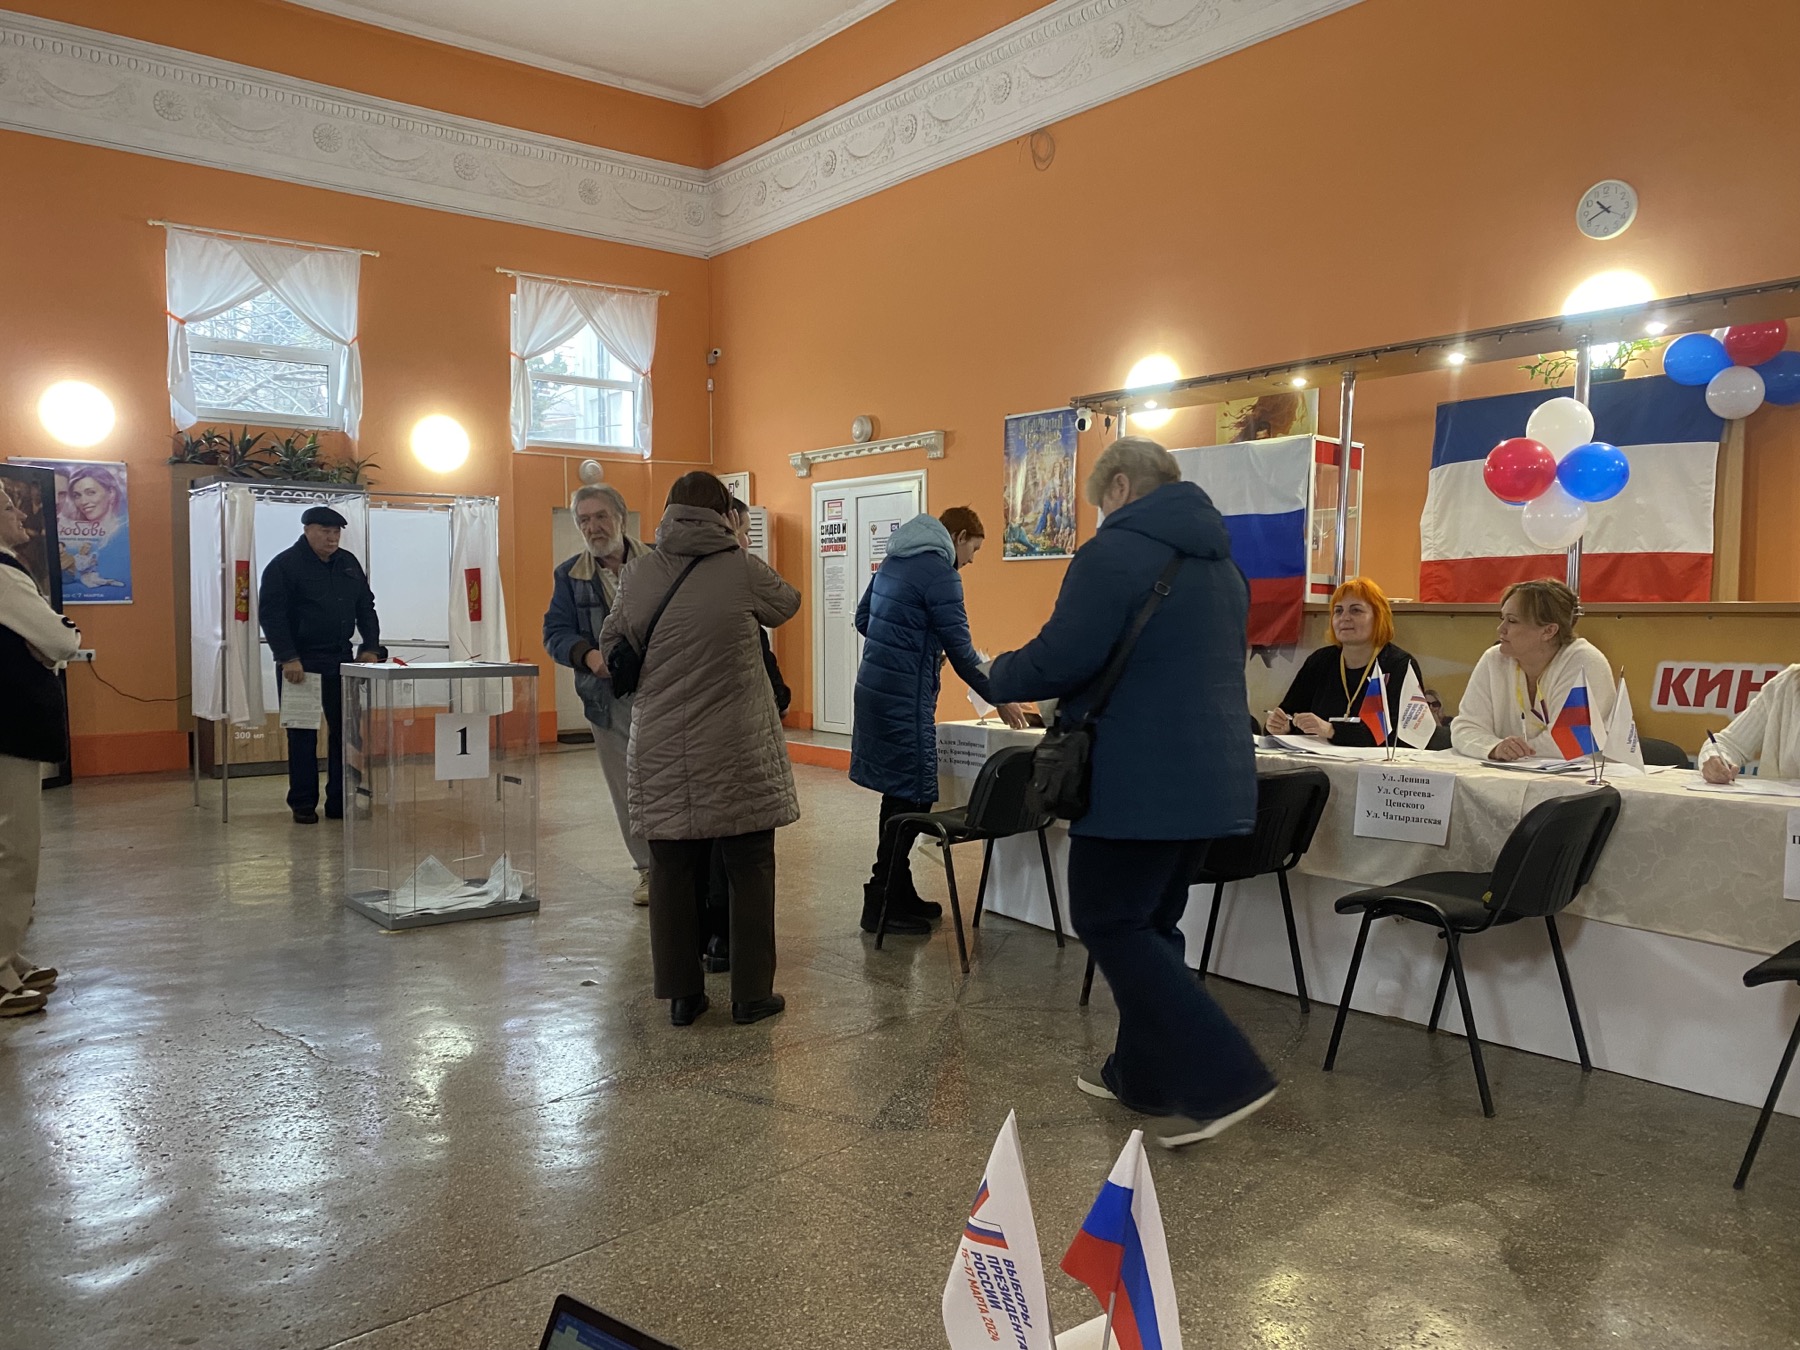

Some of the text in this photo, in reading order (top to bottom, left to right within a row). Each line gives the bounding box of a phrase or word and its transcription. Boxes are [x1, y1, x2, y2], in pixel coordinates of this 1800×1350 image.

[1603, 186, 1609, 194] 12
[1620, 192, 1626, 200] 2
[1586, 200, 1593, 208] 10
[1624, 201, 1629, 209] 3
[59, 522, 106, 536] юбовь
[821, 523, 846, 536] ВИДЕО И
[1657, 668, 1779, 714] КИН
[234, 731, 251, 740] 300
[456, 726, 471, 756] 1
[1382, 773, 1430, 785] Ул. Ленина
[1377, 786, 1435, 798] Ул. Сергеева-
[1385, 799, 1425, 810] Ценского
[1366, 810, 1442, 825] Ул. Чатырдагская
[970, 1250, 1003, 1311] РОССИИ
[1002, 1258, 1033, 1328] ВЫБОРЫ
[986, 1254, 1029, 1350] ПРЕЗИДЕНТА
[968, 1278, 990, 1314] МАРТА
[982, 1315, 1000, 1342] 2024
